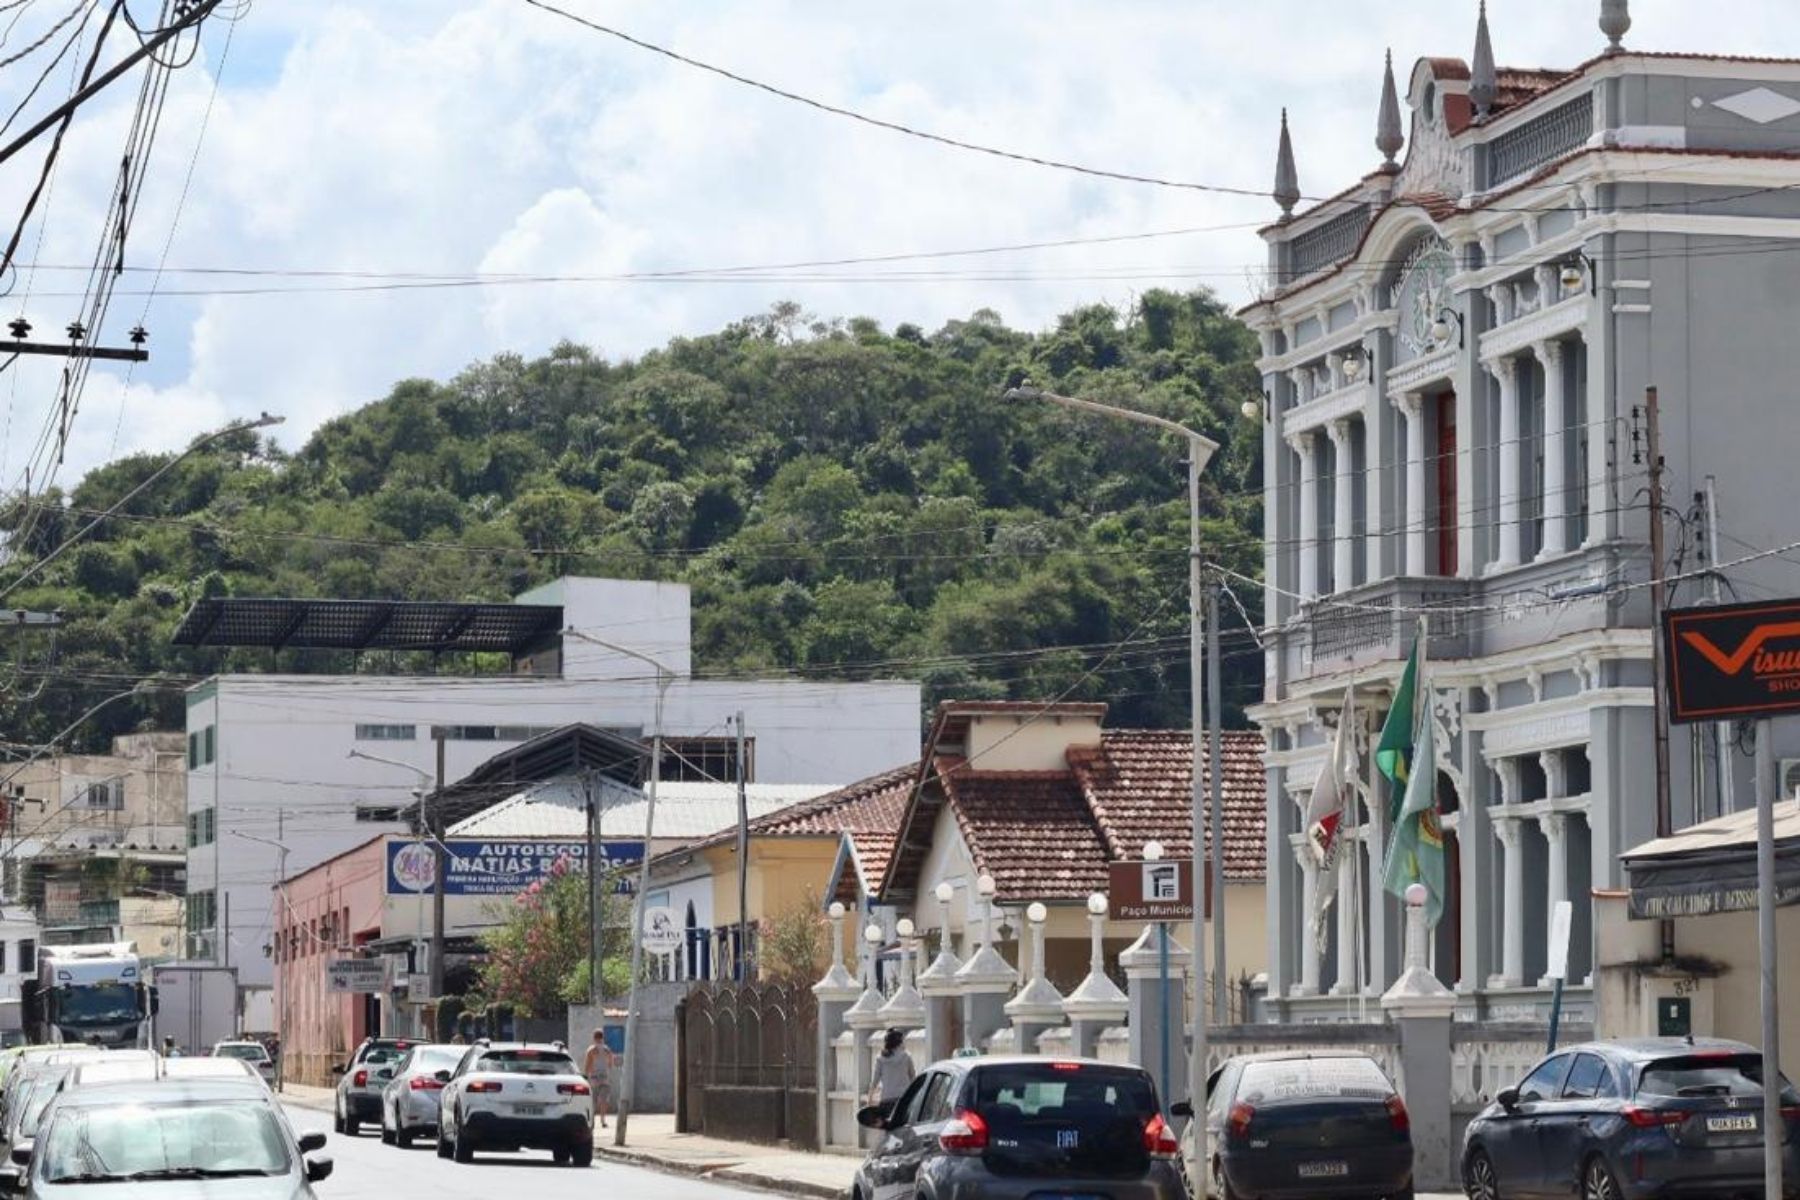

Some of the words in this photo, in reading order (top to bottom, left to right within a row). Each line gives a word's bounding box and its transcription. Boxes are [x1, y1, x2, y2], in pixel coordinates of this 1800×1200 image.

[451, 857, 532, 873] MATIAS
[1120, 905, 1148, 917] Paço
[1057, 1130, 1079, 1148] FIAT
